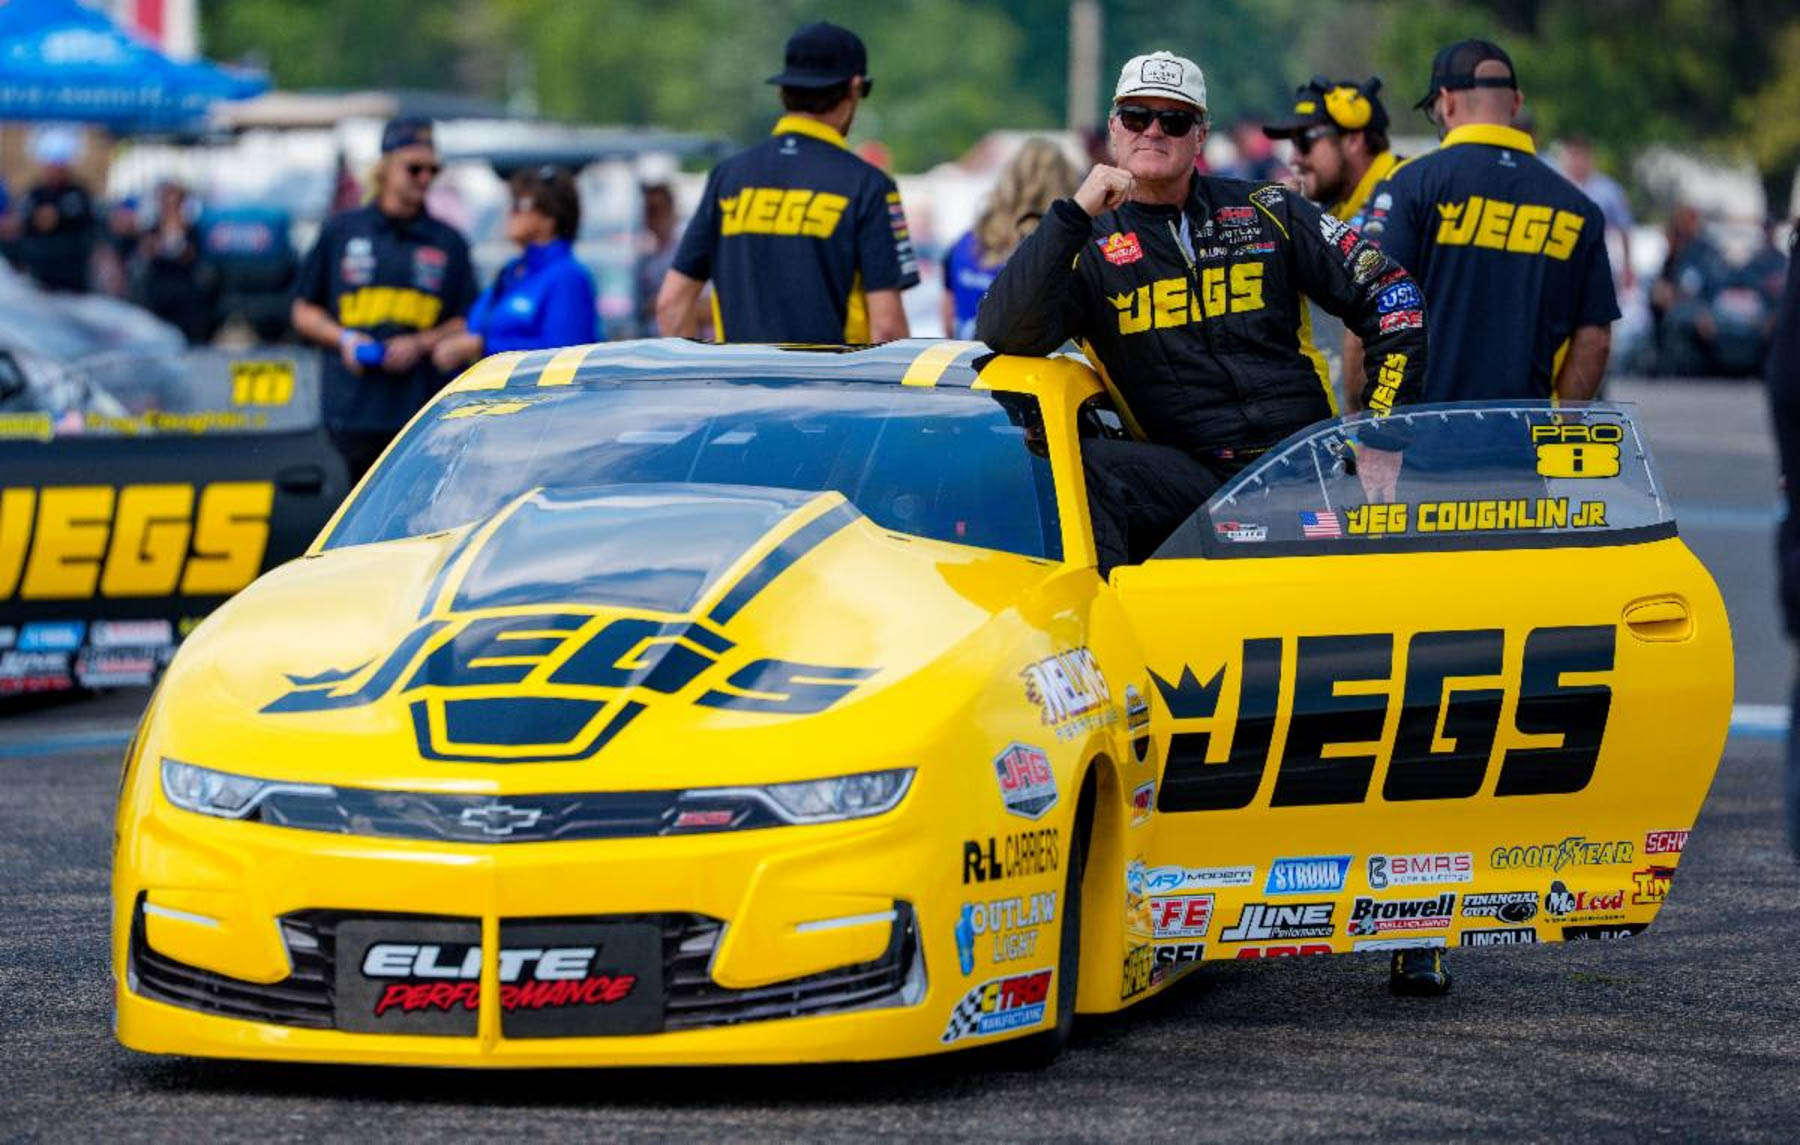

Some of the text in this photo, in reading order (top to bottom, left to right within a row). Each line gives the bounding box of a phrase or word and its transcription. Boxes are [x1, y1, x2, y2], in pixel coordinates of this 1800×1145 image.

[720, 187, 848, 238] JEGS
[1437, 195, 1585, 261] JEGS
[1107, 262, 1265, 336] JEGS
[1531, 424, 1623, 443] PRO
[1536, 443, 1620, 478] 8
[1345, 497, 1609, 534] JEG COUGHLIN JR
[258, 612, 883, 714] JEGS
[1147, 624, 1617, 813] JEGS
[1001, 749, 1049, 790] JHG
[1391, 855, 1470, 874] BMRS
[1491, 837, 1634, 872] GOODYEAR
[1273, 861, 1340, 891] STROUD
[971, 891, 1057, 935] OUTLAW
[1351, 894, 1456, 920] Browell
[1462, 906, 1499, 917] GUYS
[1464, 893, 1539, 906] FINANCIAL
[1549, 888, 1624, 912] McLeod
[362, 944, 597, 981] ELITE
[993, 930, 1039, 963] LIGHT
